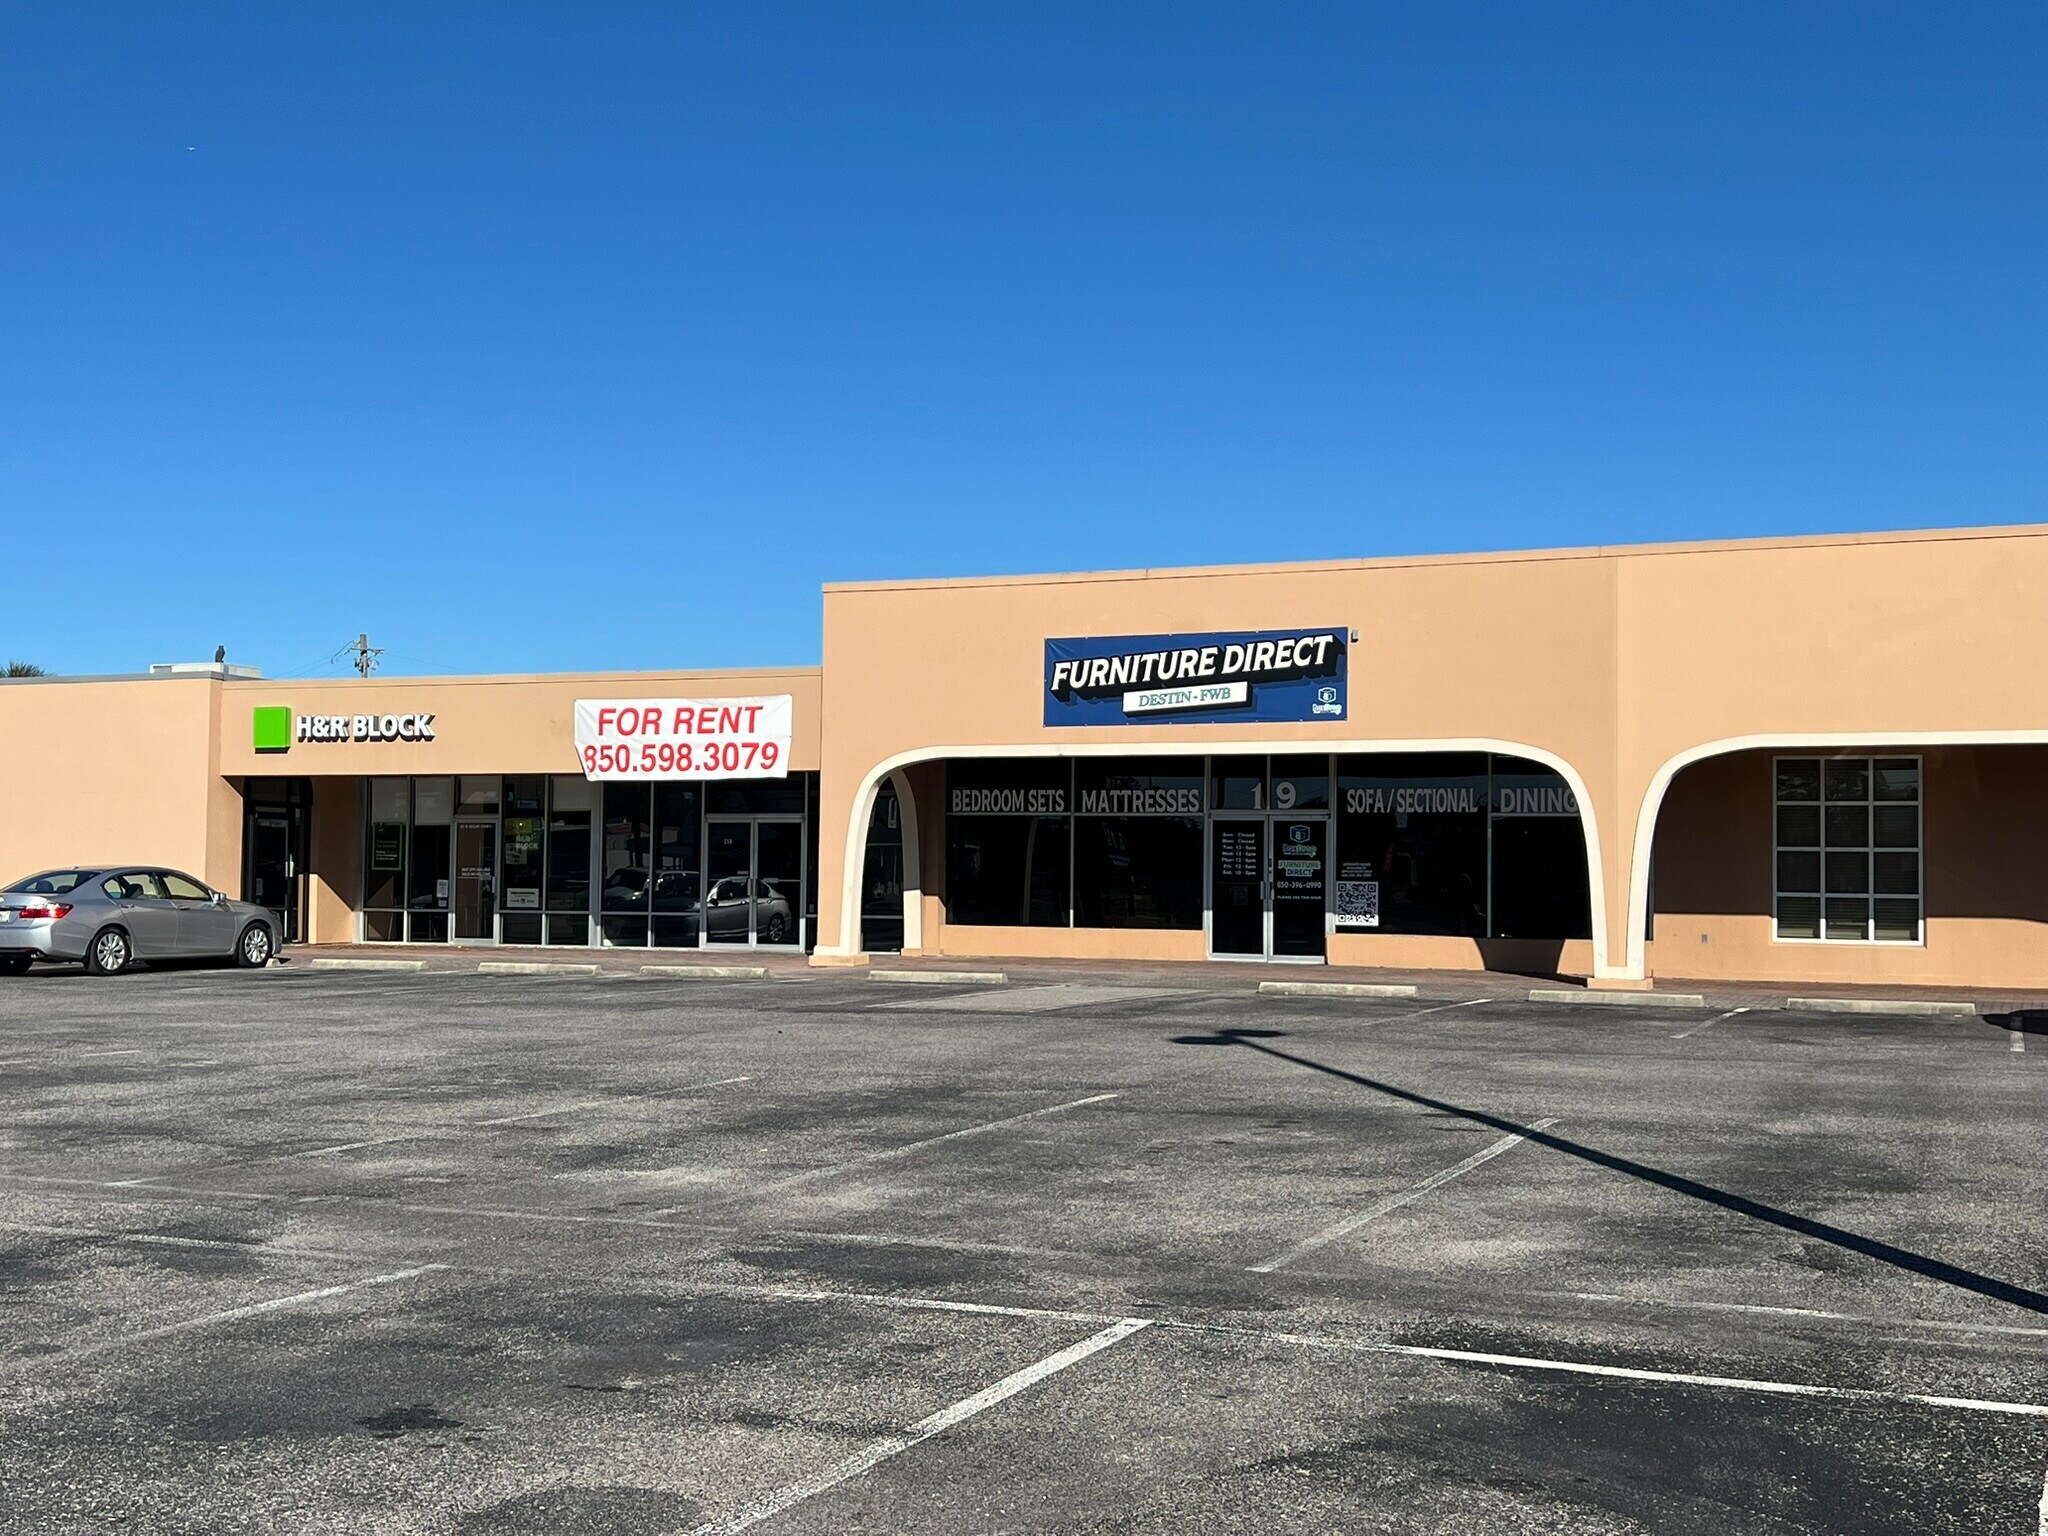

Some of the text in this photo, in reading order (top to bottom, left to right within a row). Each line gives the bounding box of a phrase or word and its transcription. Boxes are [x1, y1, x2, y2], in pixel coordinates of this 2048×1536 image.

[1051, 634, 1334, 691] FURNITURE DIRECT
[1138, 690, 1192, 707] DESTIN
[1200, 687, 1232, 701] FWB
[296, 713, 436, 739] H&R BLOCK
[598, 705, 764, 736] FOR RENT
[584, 741, 779, 774] 850.598.3079
[952, 789, 1065, 813] BEDROOM SETS
[1081, 789, 1200, 813] MATTRESSES
[1346, 788, 1385, 813] SOFA
[1396, 788, 1479, 813] SECTIONAL
[1500, 788, 1579, 813] DINING
[1278, 861, 1321, 869] FURNITURE
[1286, 868, 1313, 876] DIRECT
